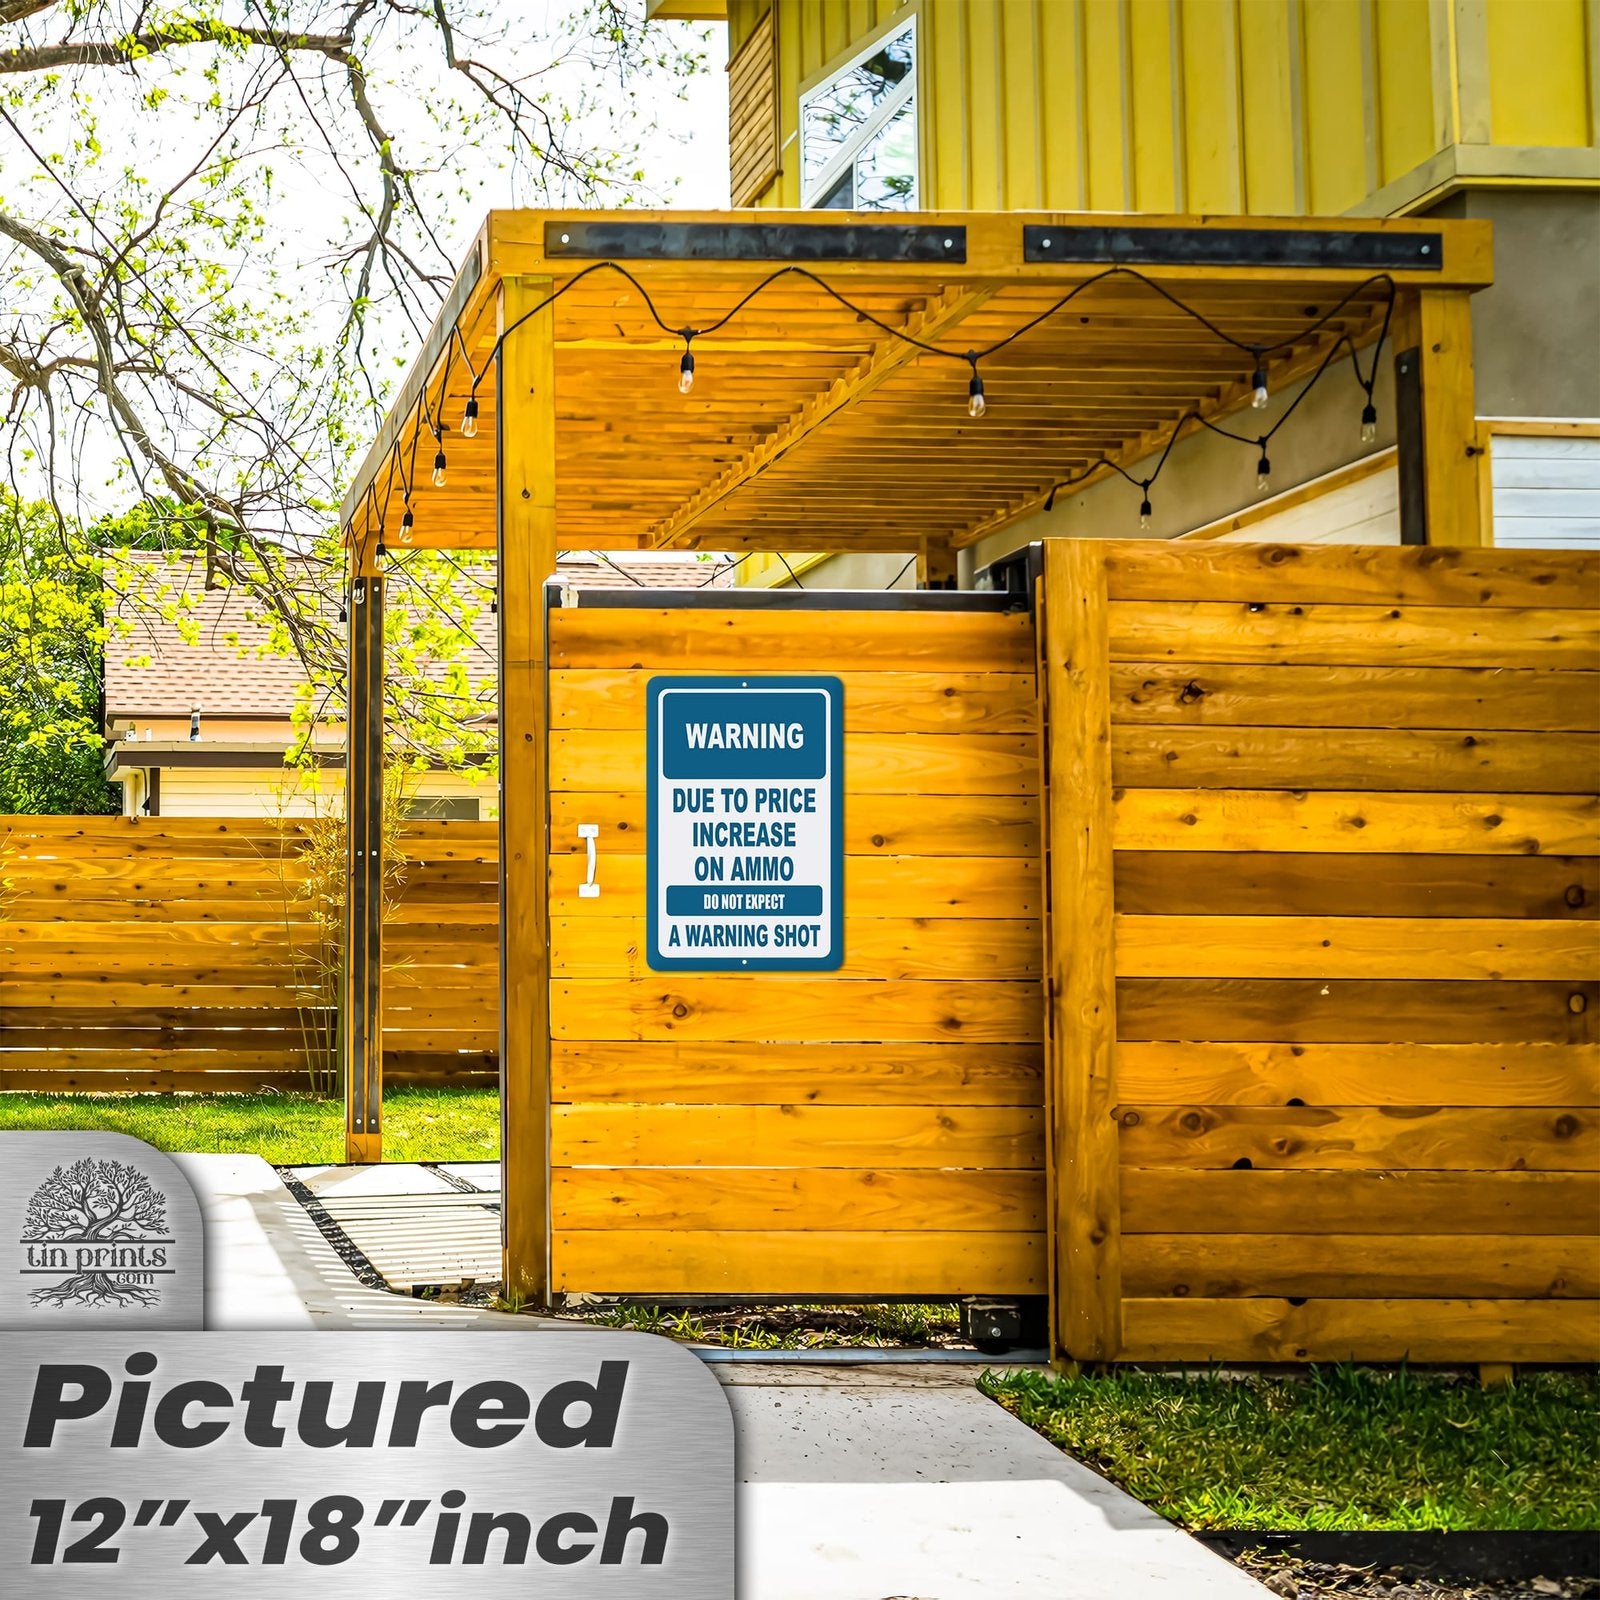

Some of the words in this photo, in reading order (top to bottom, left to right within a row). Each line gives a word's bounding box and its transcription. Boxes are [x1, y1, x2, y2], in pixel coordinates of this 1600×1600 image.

[685, 722, 805, 750] WARNING
[672, 787, 715, 813] DUE
[721, 787, 749, 813] TO
[755, 787, 817, 813] PRICE
[692, 822, 797, 847] INCREASE
[694, 856, 724, 882] ON
[730, 856, 794, 882] AMMO
[703, 893, 720, 910] DO
[721, 893, 744, 910] NOT
[745, 893, 785, 910] EXPECT
[668, 924, 681, 948] A
[685, 924, 768, 948] WARNING
[773, 924, 821, 948] SHOT
